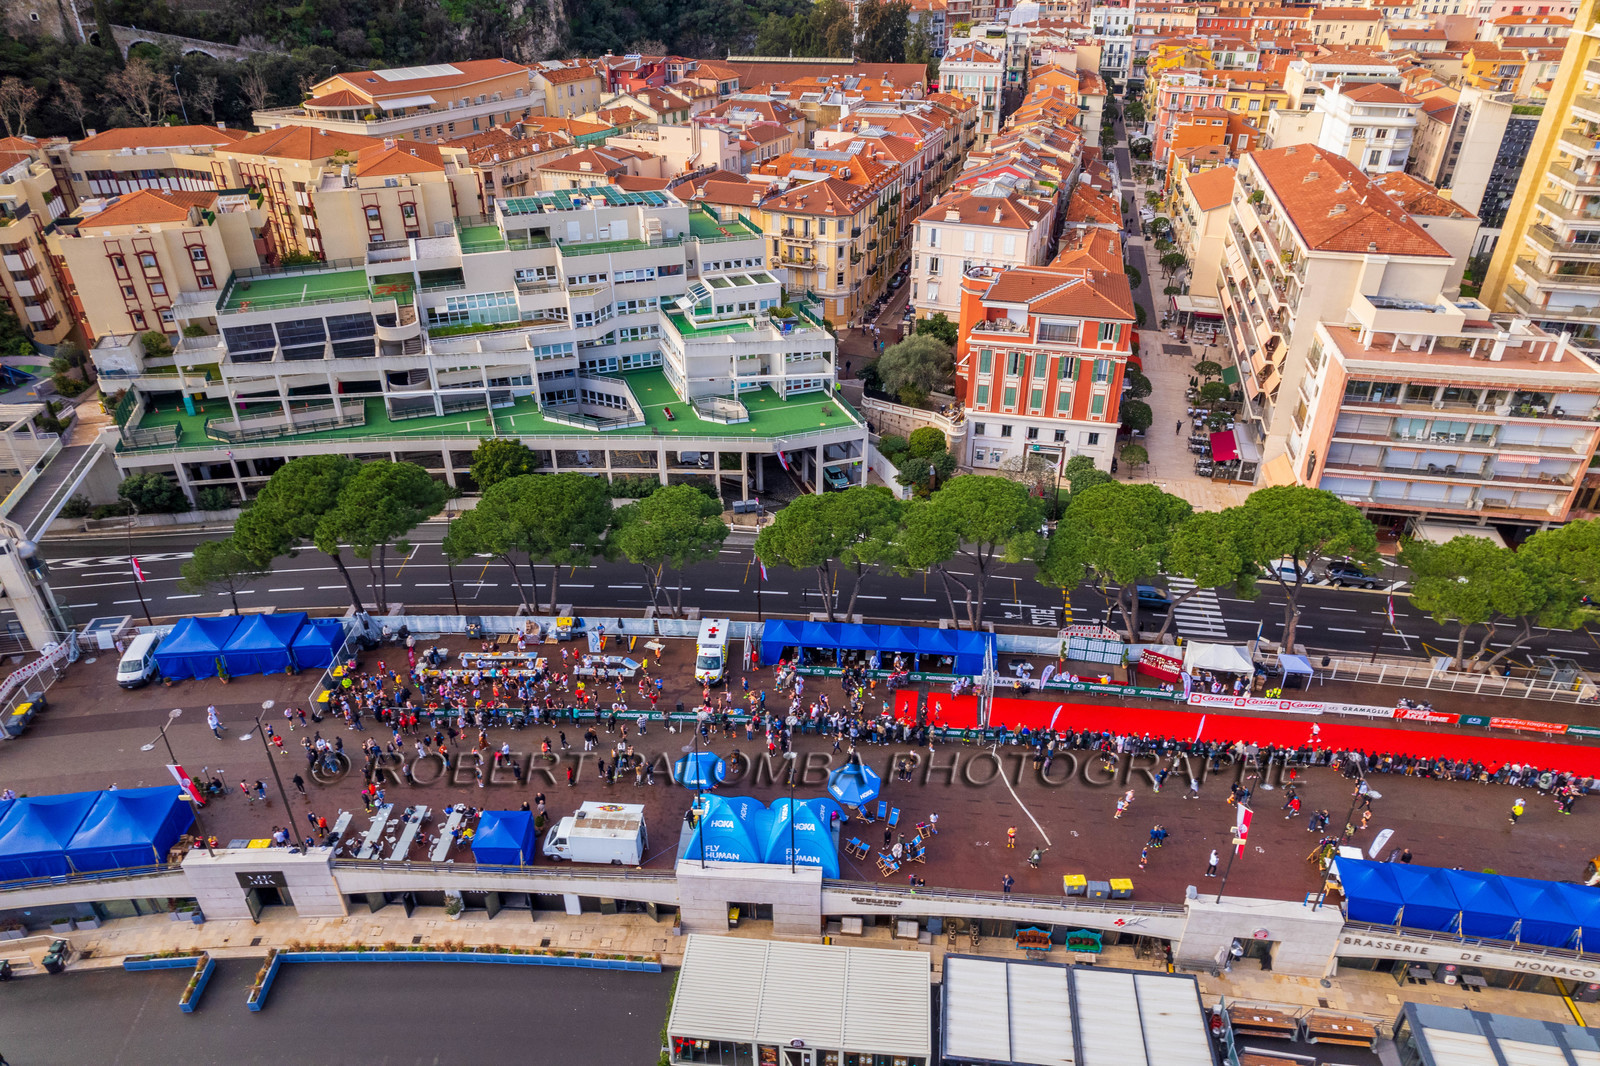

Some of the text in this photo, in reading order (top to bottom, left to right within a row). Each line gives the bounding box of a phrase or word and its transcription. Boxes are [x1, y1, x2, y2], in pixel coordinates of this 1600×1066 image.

[1246, 698, 1279, 706] Casino
[1342, 706, 1389, 715] GRAMAGLIA
[711, 820, 734, 829] HOKA
[793, 823, 815, 831] HOKA
[705, 852, 740, 860] HUMAN
[1343, 937, 1595, 979] BRASSERIE DE MONACO
